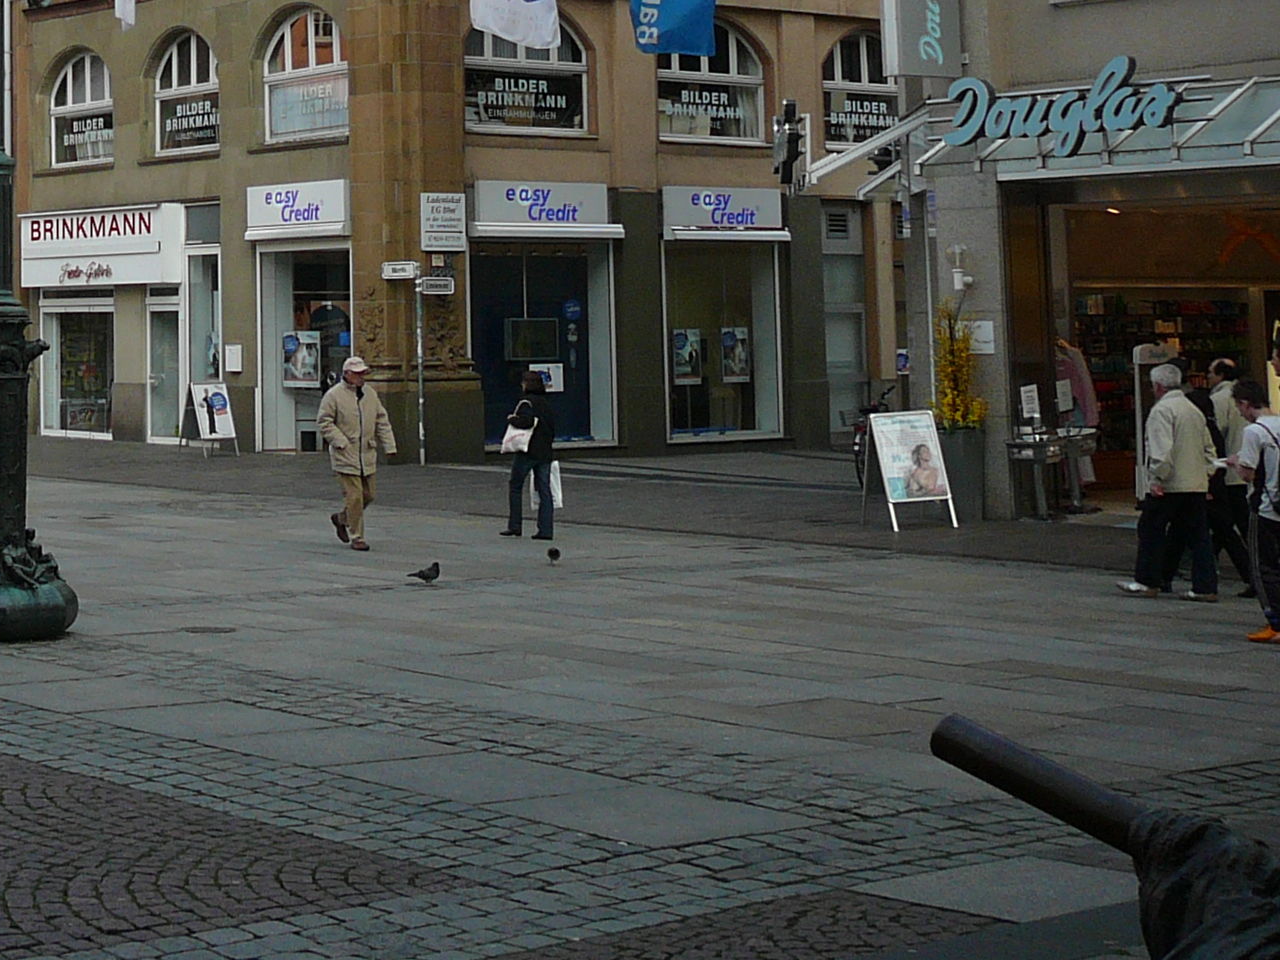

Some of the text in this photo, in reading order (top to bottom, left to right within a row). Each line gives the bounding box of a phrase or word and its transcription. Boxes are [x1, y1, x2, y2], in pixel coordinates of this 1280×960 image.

[495, 78, 548, 93] BILDER
[477, 91, 567, 109] BRINKMANN
[681, 90, 728, 105] BILDER
[943, 55, 1181, 157] Douglas
[175, 101, 212, 117] BILDER
[844, 100, 887, 114] BILDER
[73, 117, 104, 133] BILDER
[265, 190, 299, 207] easy
[506, 188, 551, 207] easy
[691, 193, 731, 211] easy
[281, 202, 320, 223] Credit
[528, 203, 578, 221] Credit
[711, 207, 756, 225] Credit
[30, 211, 151, 241] BRINKMANN
